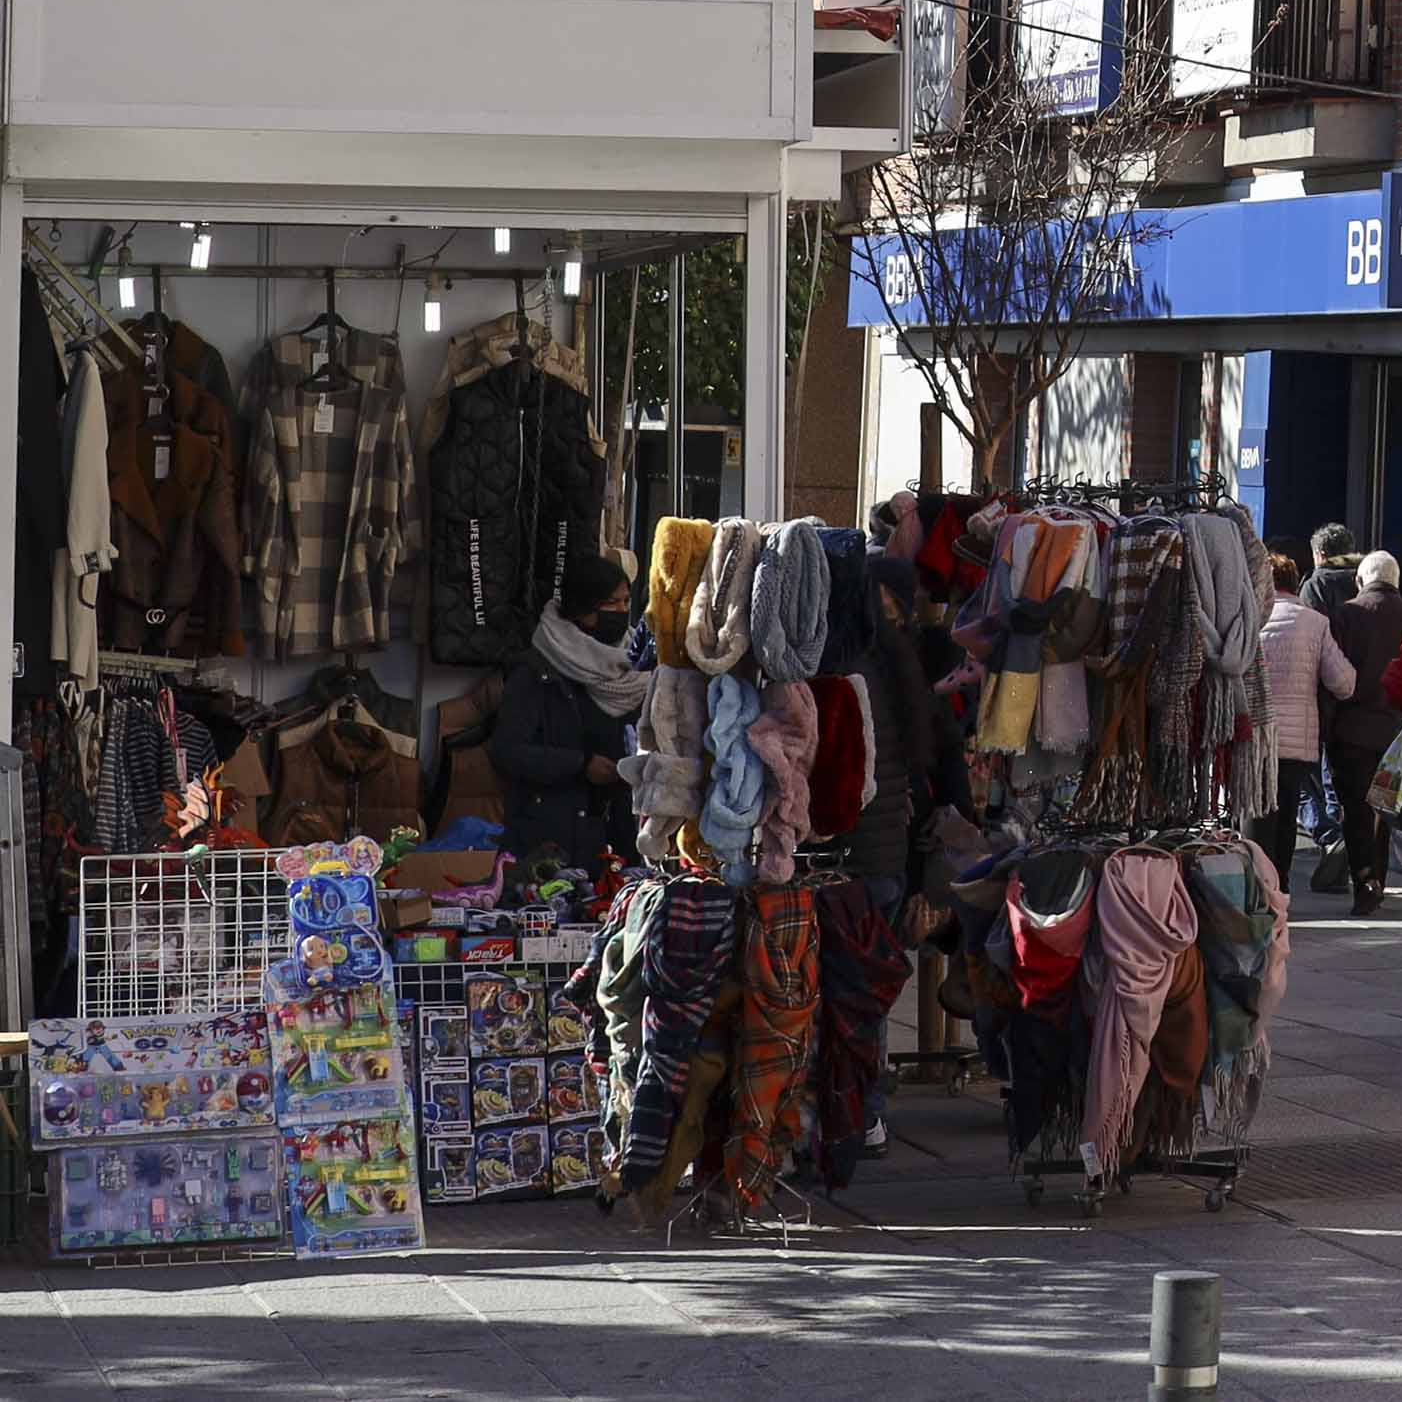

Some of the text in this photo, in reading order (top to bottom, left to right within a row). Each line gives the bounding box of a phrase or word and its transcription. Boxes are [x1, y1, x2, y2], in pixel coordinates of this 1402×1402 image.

[1346, 218, 1382, 285] BB
[470, 519, 480, 541] LIFE
[470, 542, 480, 553] IS
[470, 555, 483, 610] BEAUTIFUL
